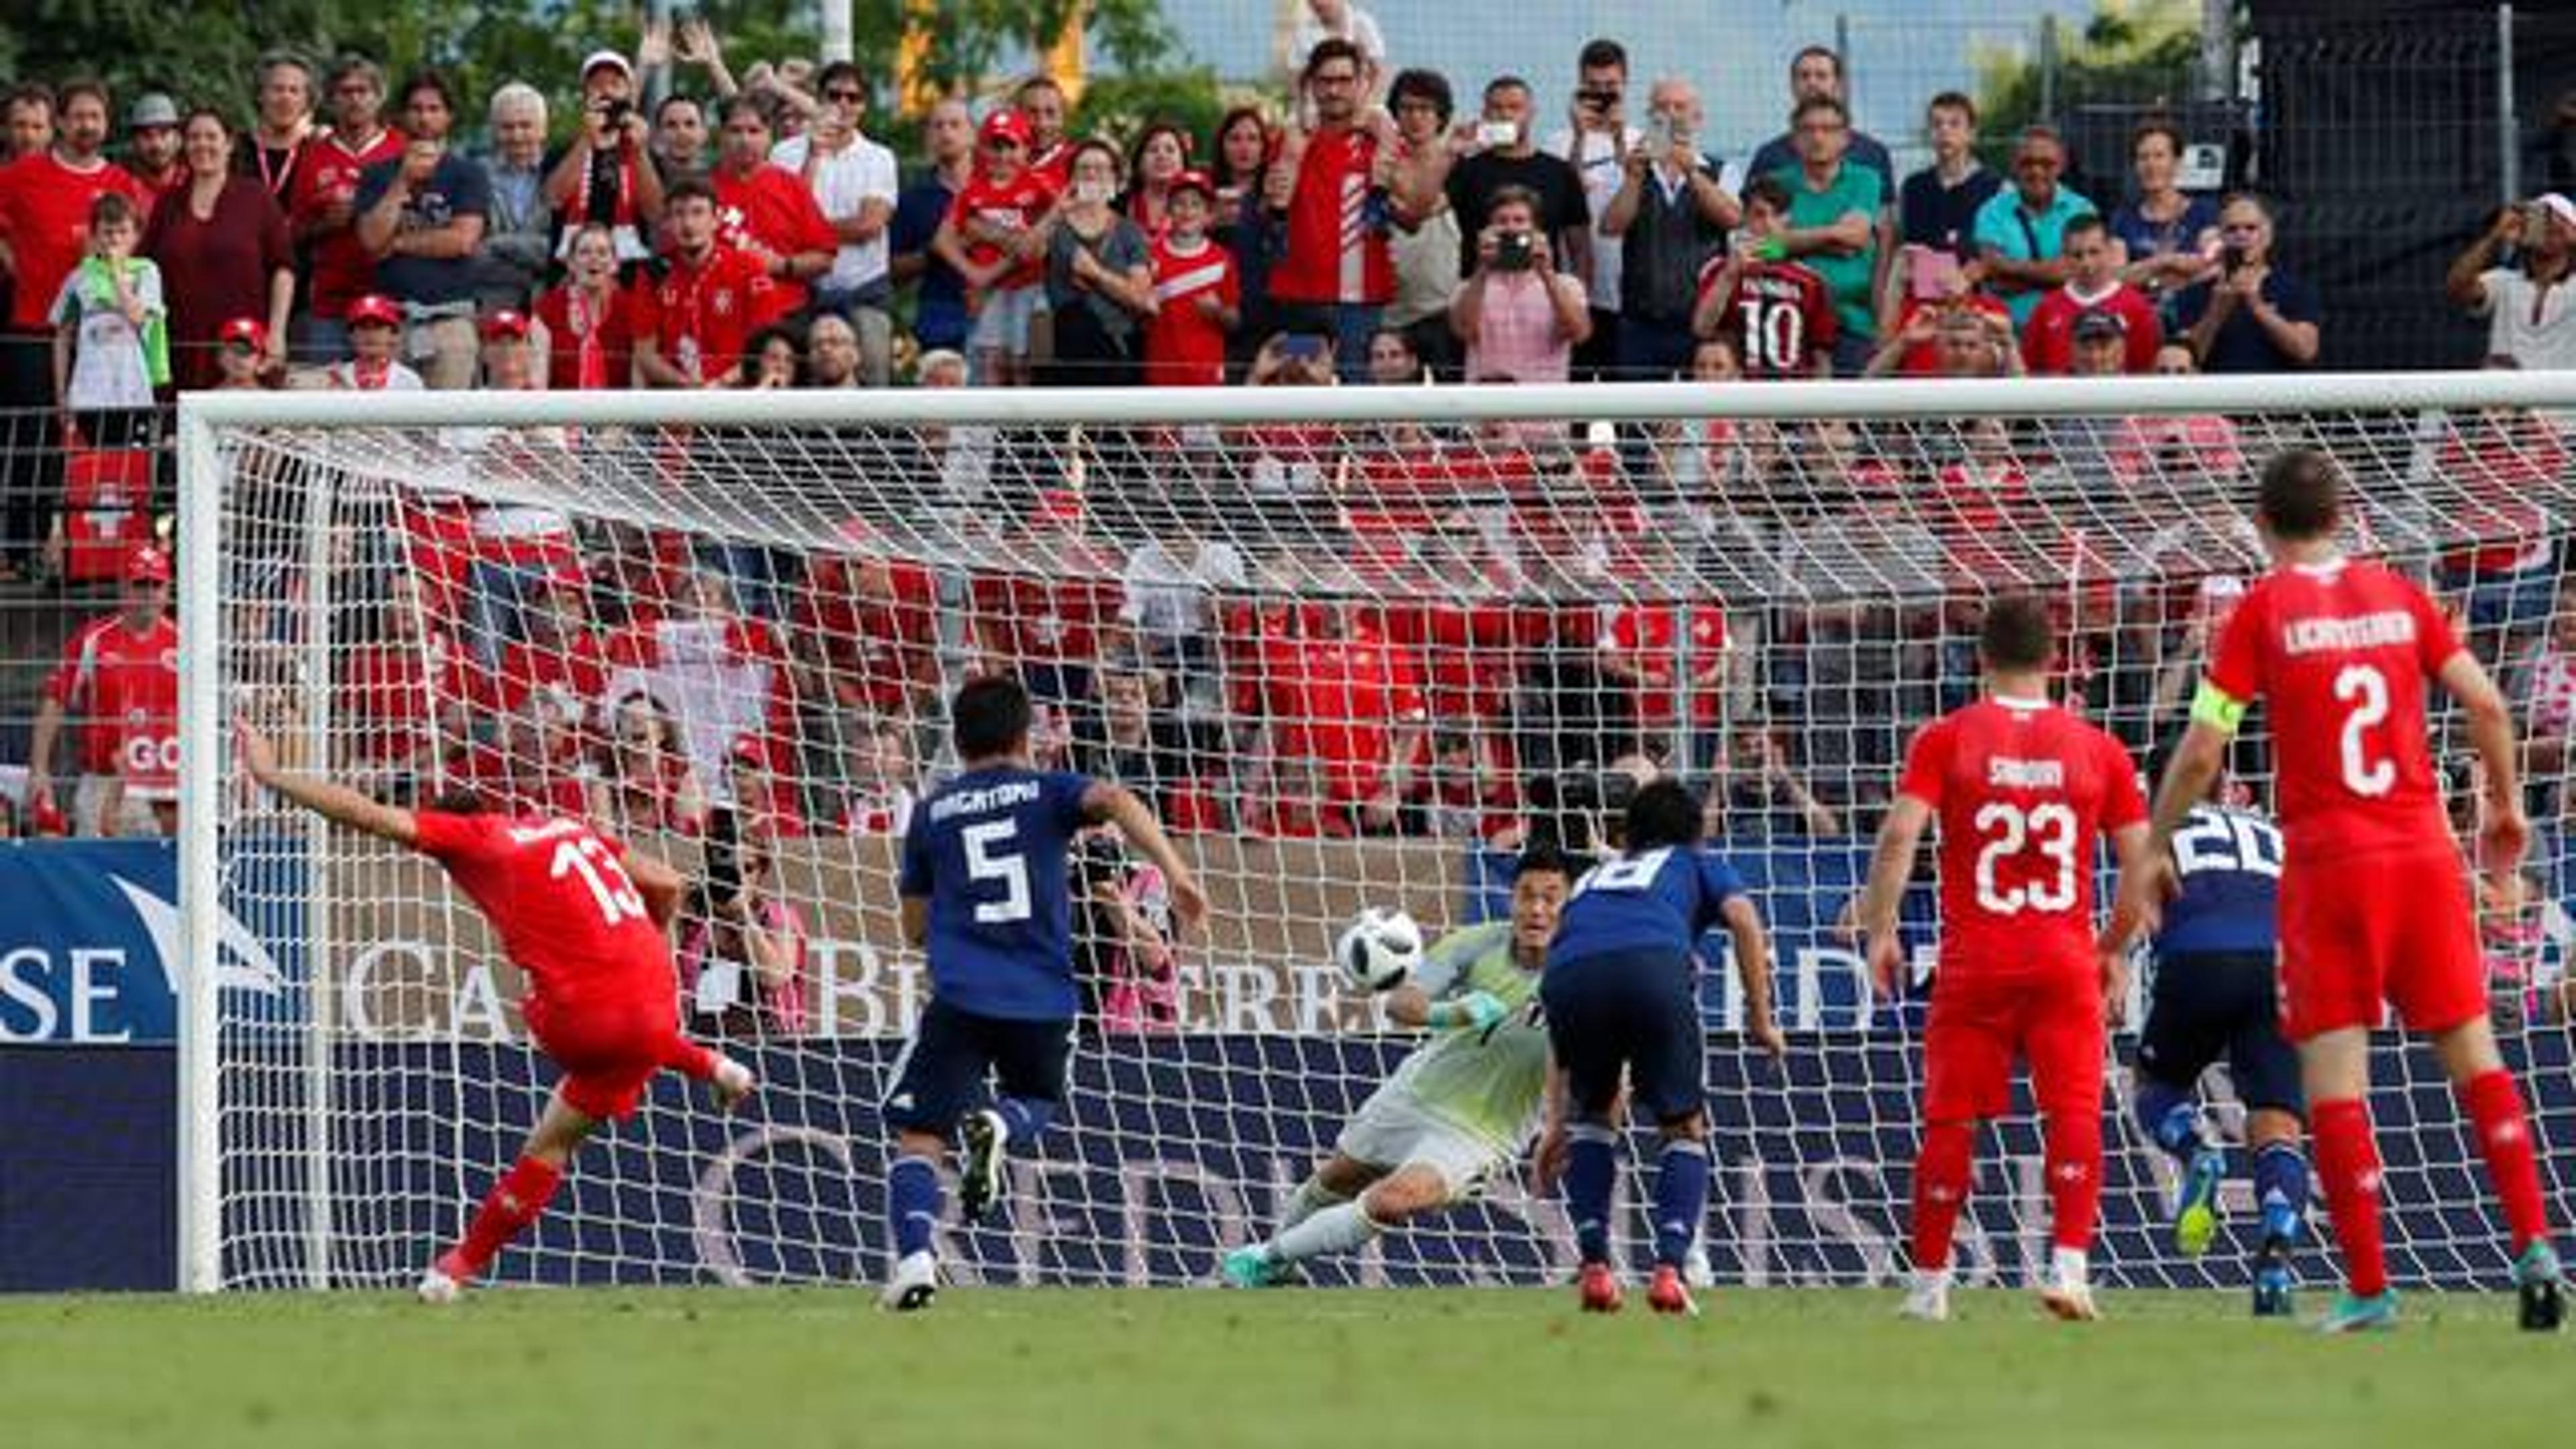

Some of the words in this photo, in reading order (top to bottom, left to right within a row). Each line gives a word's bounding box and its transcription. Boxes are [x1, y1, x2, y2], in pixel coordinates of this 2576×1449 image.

[1737, 301, 1803, 368] 10
[2333, 664, 2397, 796] 2
[549, 838, 647, 926] 13
[961, 817, 1031, 923] 5
[1976, 802, 2077, 913] 23
[2171, 808, 2285, 877] 20
